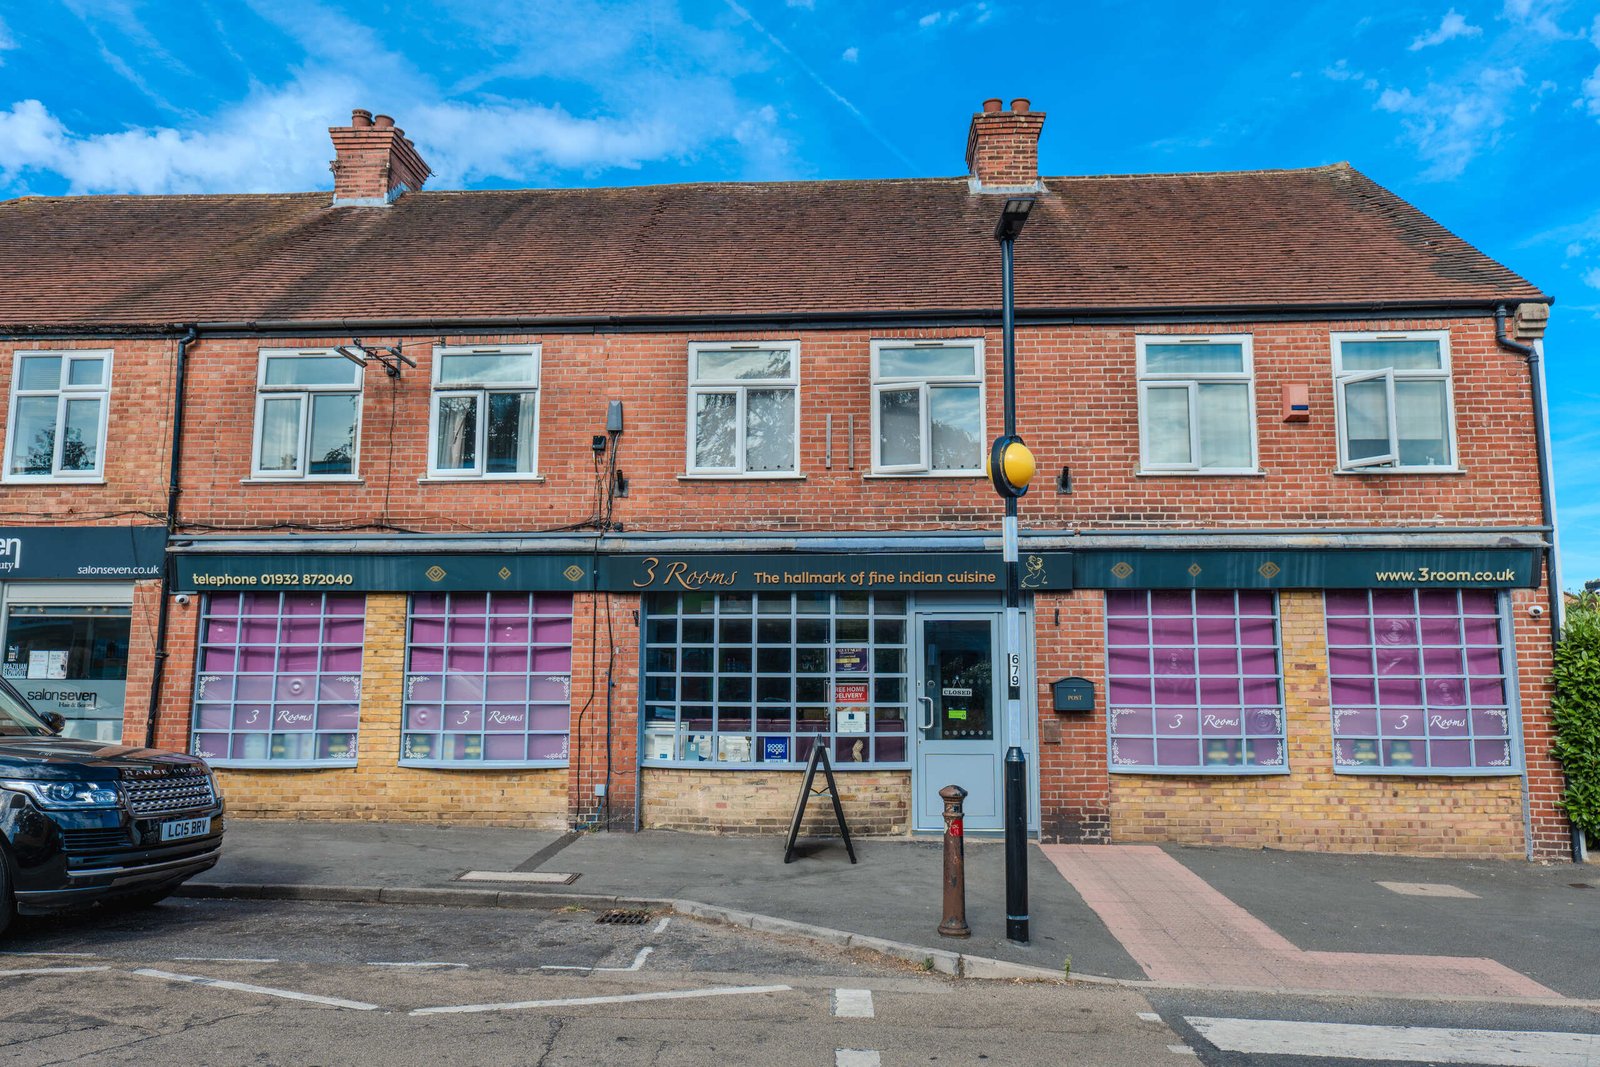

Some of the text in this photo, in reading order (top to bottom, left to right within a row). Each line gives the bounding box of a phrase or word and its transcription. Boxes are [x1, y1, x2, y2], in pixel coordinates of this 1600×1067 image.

[77, 565, 159, 575] salonseven.co.uk
[633, 557, 738, 590] 3 Rooms
[1376, 567, 1515, 582] www.3room.co.uk
[192, 573, 353, 587] telephone 01932 872040
[753, 571, 996, 586] The hallmark of fine indian cuisine
[27, 688, 98, 708] salonseven
[246, 709, 312, 724] 3 Rooms
[457, 710, 524, 725] 3 Rooms
[1169, 714, 1239, 729] 3 Rooms
[1394, 714, 1466, 730] 3 Rooms
[168, 822, 190, 838] LC15
